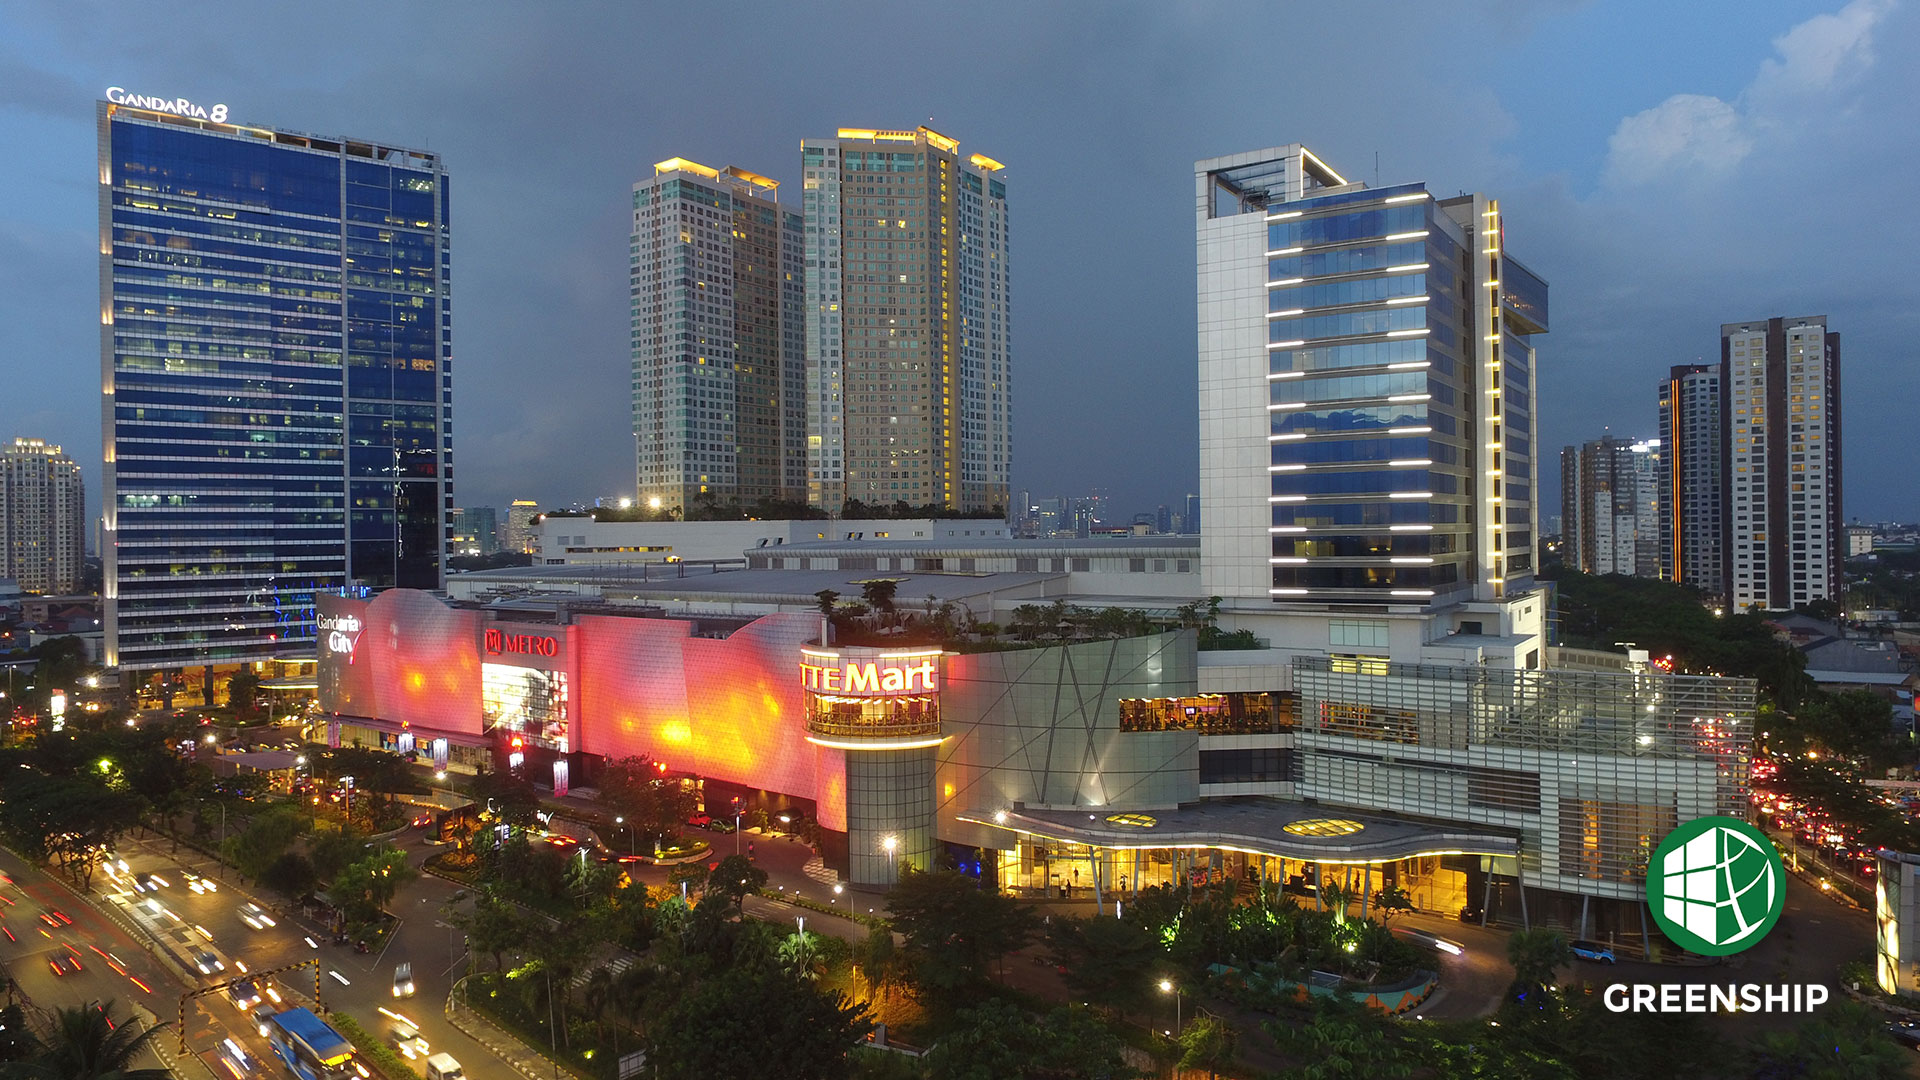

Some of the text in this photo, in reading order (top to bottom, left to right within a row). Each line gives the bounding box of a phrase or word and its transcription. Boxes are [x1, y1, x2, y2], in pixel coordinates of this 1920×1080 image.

[210, 103, 229, 124] 8
[316, 613, 360, 632] Gandaria
[505, 633, 558, 657] METRO
[844, 659, 936, 693] Mart
